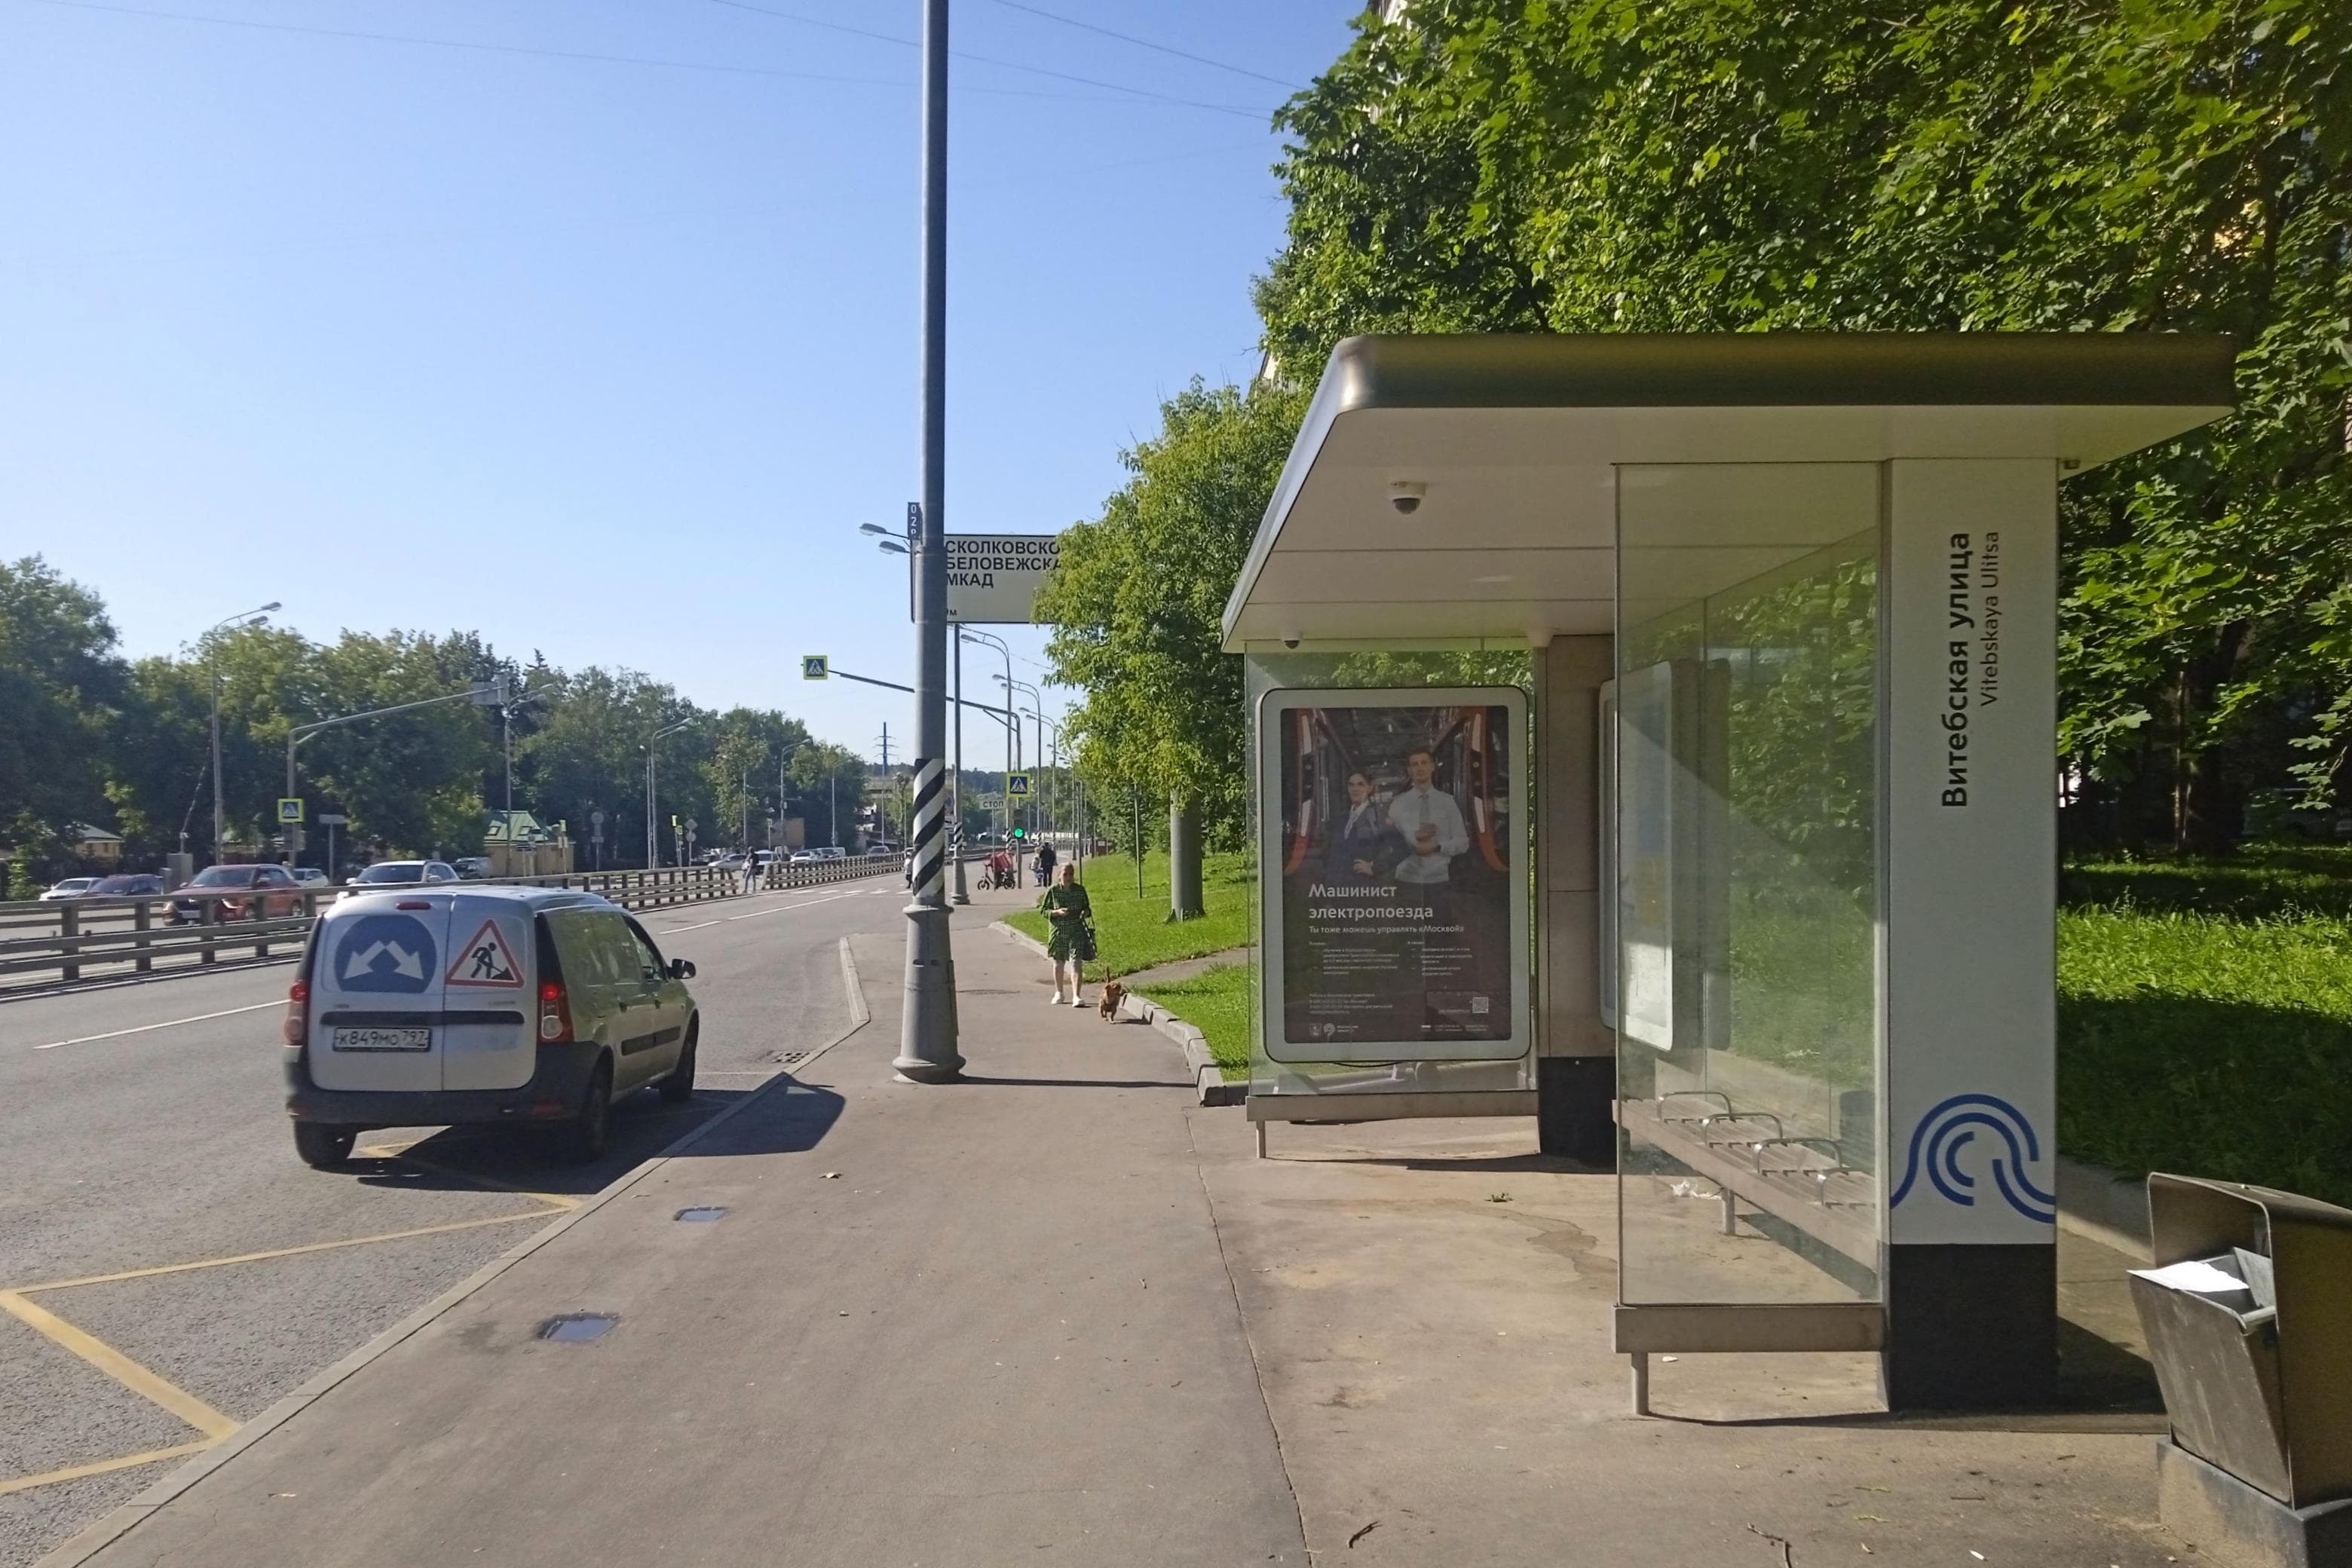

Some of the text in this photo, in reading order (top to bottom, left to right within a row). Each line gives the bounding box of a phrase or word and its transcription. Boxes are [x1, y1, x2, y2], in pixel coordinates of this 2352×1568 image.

[946, 541, 1061, 554] СКОЛКОВСКО
[947, 556, 1061, 571] БЕЛОВЕЖСКА
[947, 573, 994, 588] МКАД
[1980, 531, 2002, 706] Vitebskaya Ulitsa
[1942, 533, 1974, 807] Витебская улица
[1309, 884, 1397, 897] Машинист
[1309, 908, 1433, 921] электропоезда
